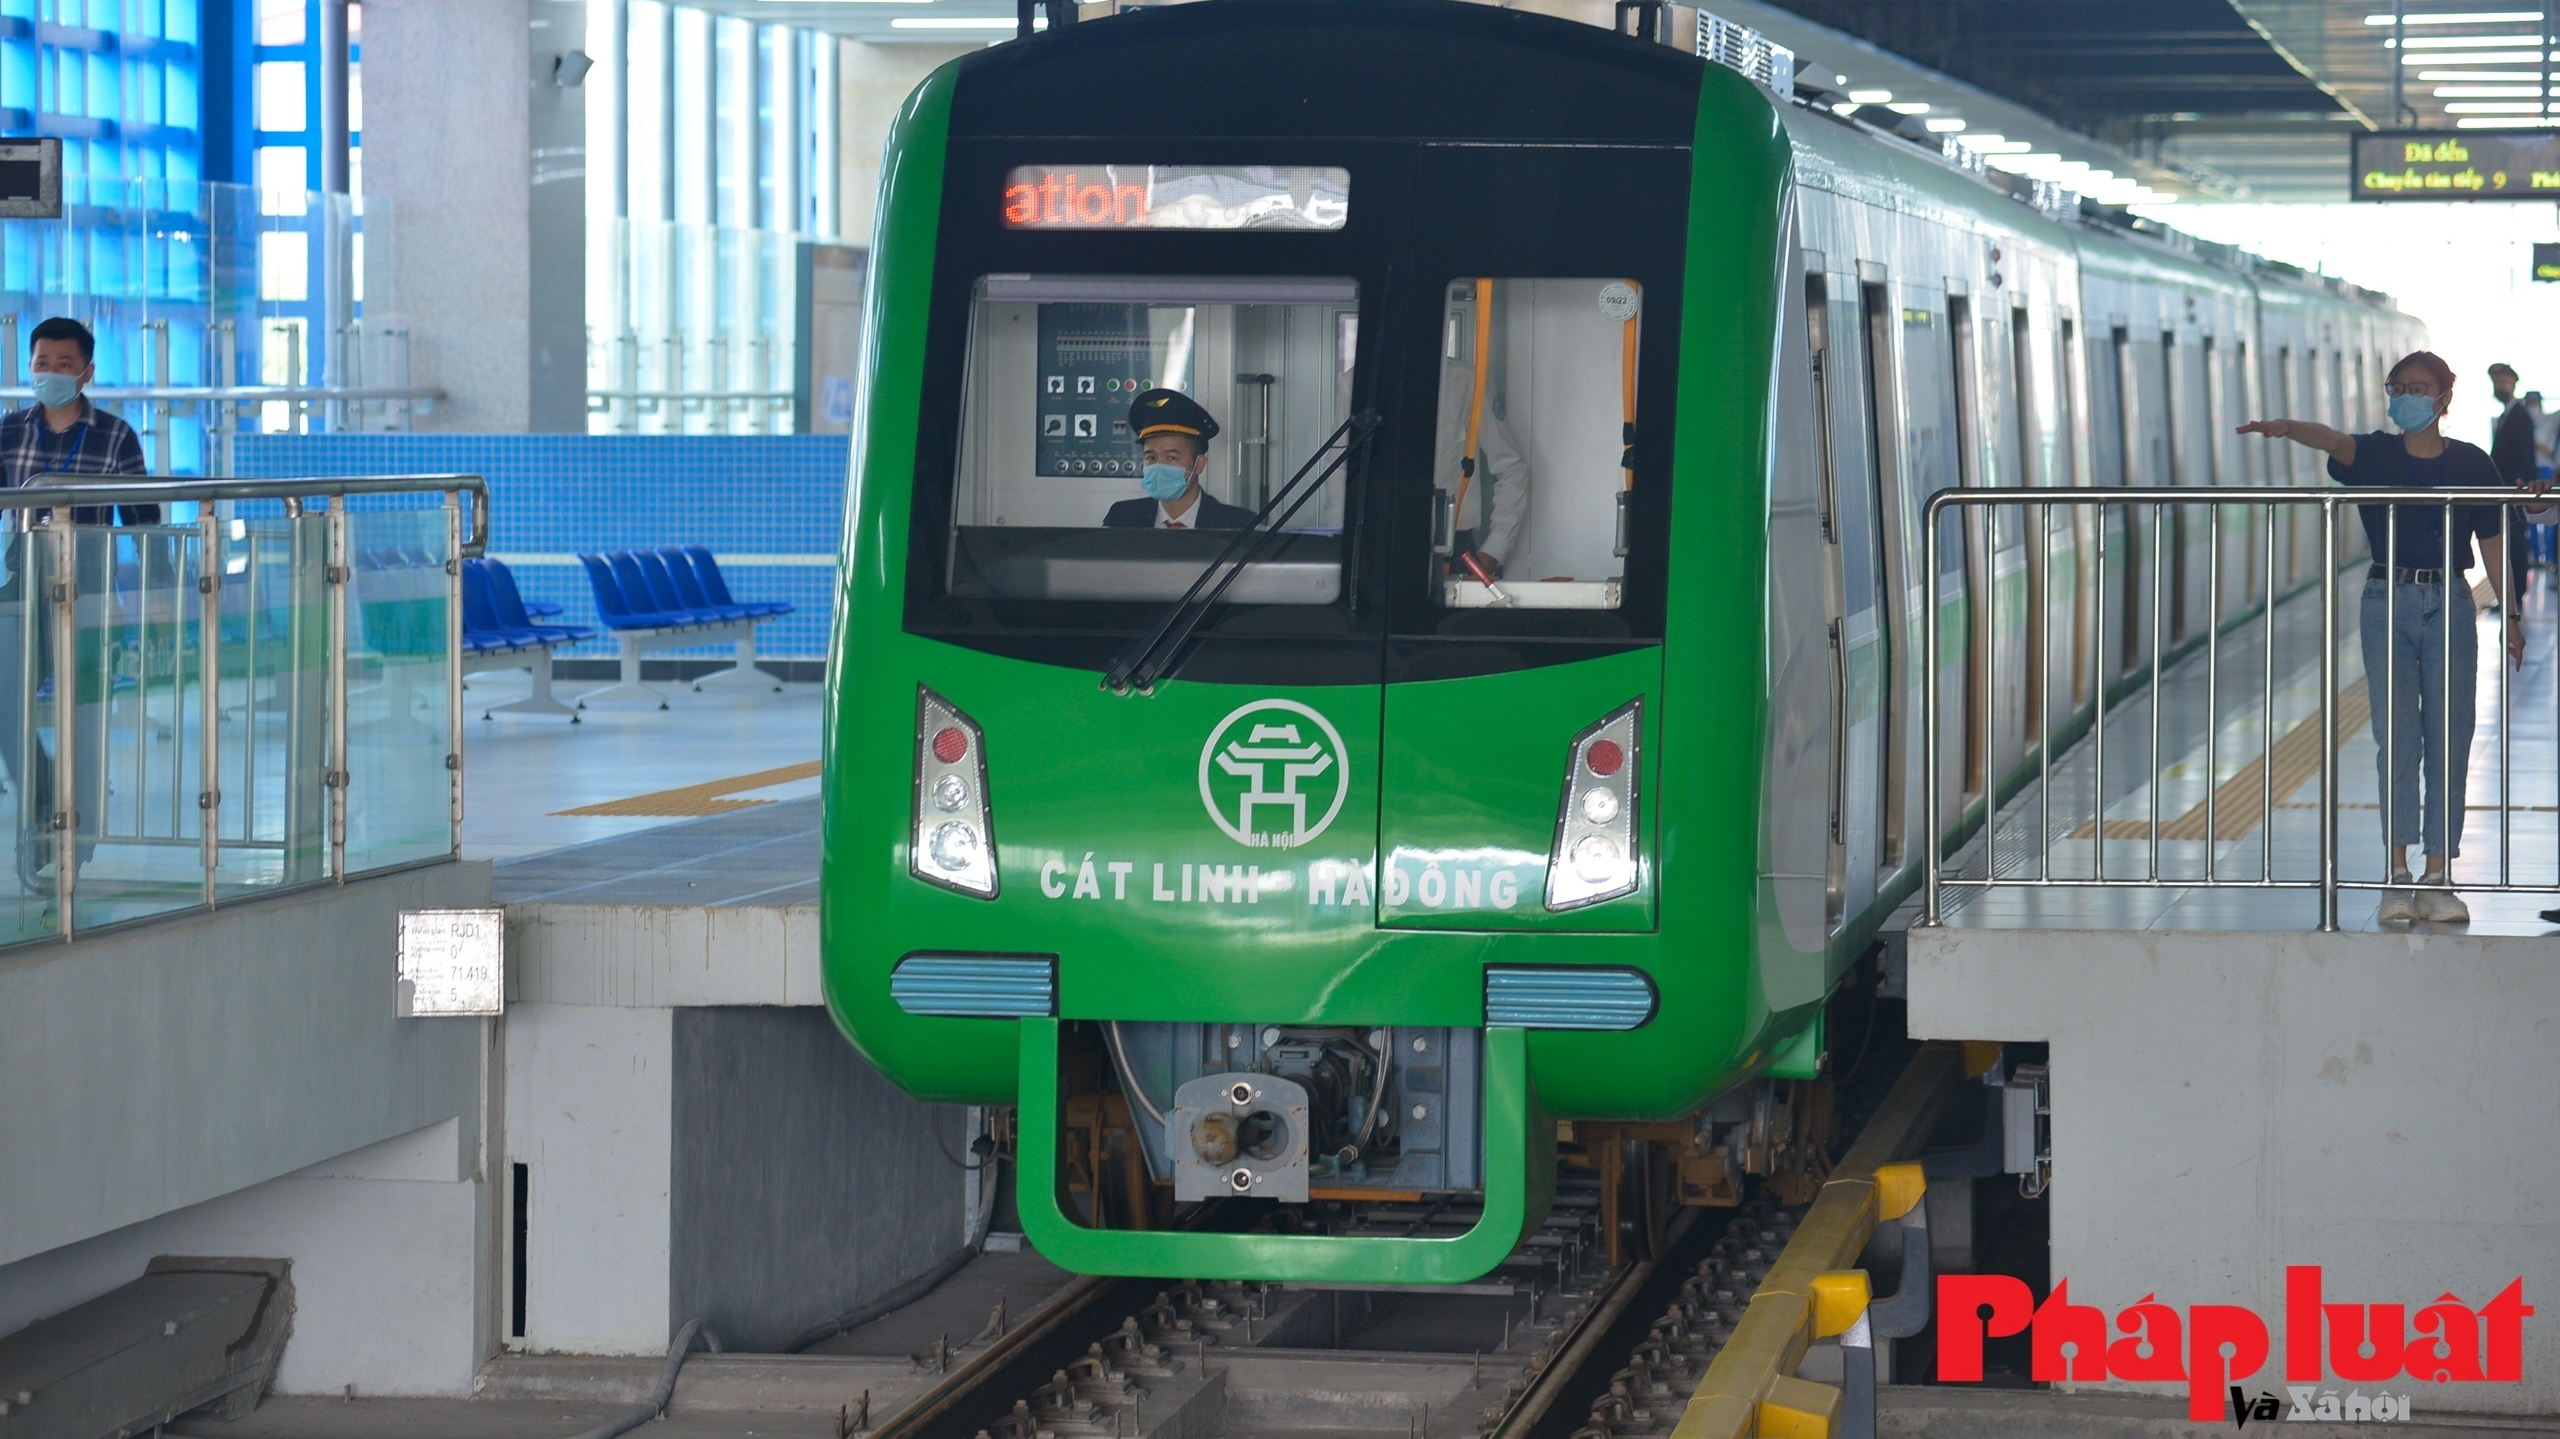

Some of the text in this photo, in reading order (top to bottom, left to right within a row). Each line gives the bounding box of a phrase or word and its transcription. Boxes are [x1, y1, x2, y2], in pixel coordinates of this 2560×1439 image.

[2493, 170, 2507, 189] 9
[1005, 173, 1147, 223] ation
[1251, 830, 1294, 851] HÀ NỘI
[1040, 851, 1133, 900] CÁT
[1153, 863, 1259, 904] LINH
[1308, 856, 1370, 906] HÀ
[1383, 861, 1518, 909] ĐÔNG
[451, 923, 480, 938] RJD1
[451, 965, 488, 980] 71.419
[450, 987, 458, 1002] 5
